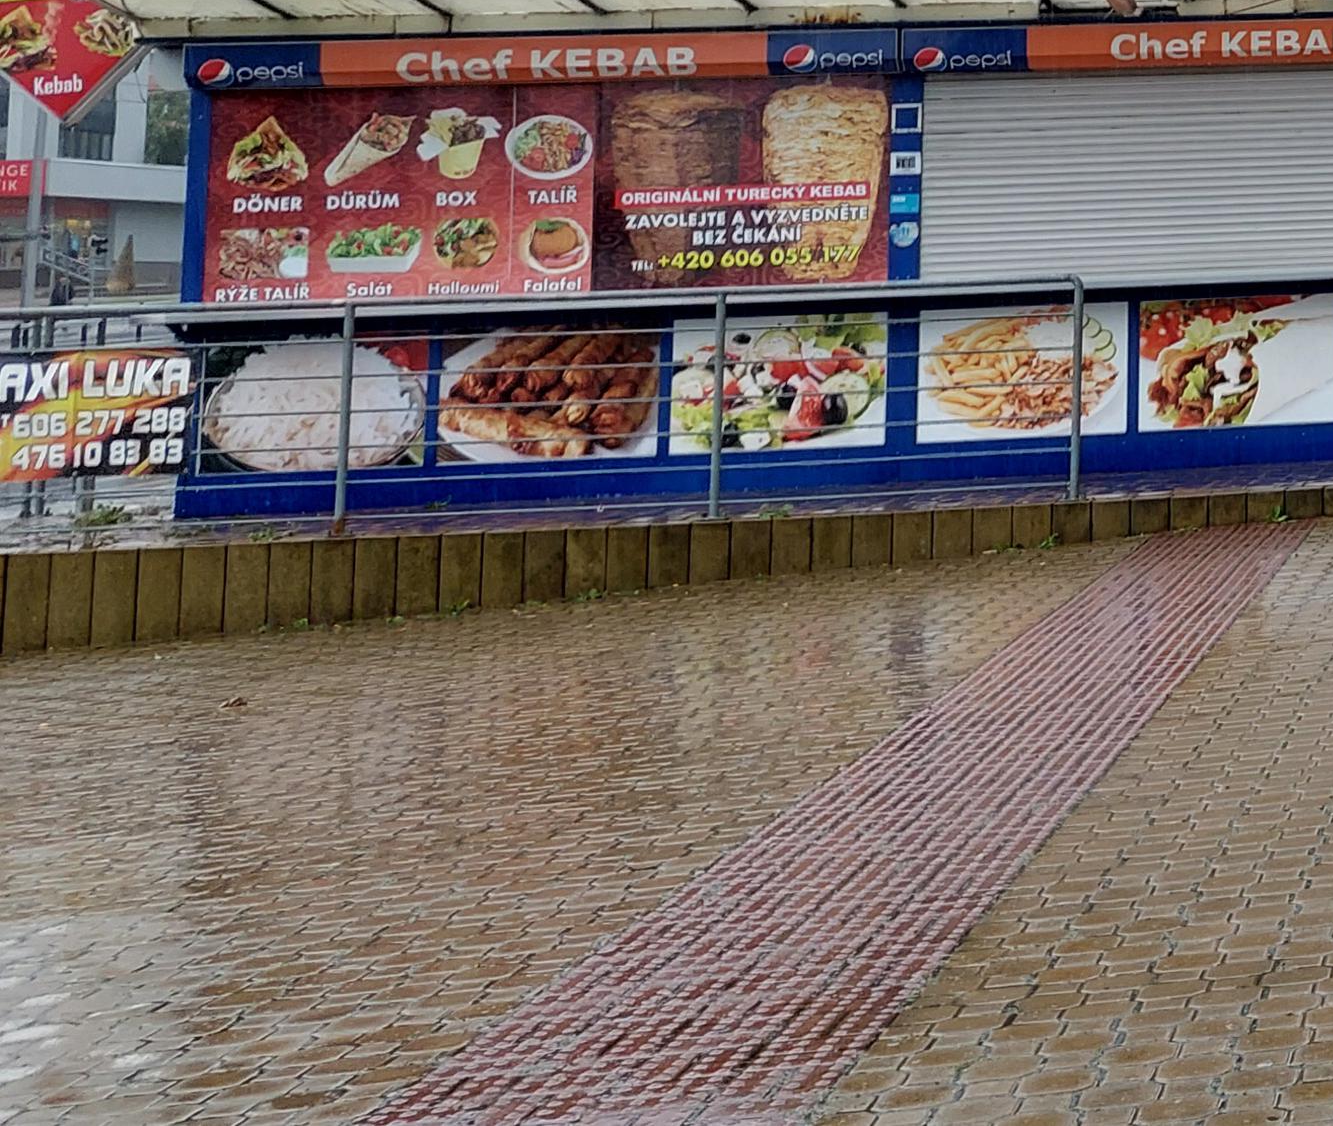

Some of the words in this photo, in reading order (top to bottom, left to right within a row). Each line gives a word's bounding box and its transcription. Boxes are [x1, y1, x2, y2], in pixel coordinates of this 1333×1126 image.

[1110, 31, 1206, 61] Chef
[396, 50, 512, 82] Chef
[531, 47, 698, 78] KEBAB
[820, 49, 883, 71] pepsi
[950, 51, 1011, 70] pepsi
[237, 62, 304, 82] pepsi
[34, 74, 82, 96] Kebab
[233, 194, 302, 213] DÖNER
[326, 191, 399, 209] DÜRÜM
[436, 191, 476, 206] BOX
[528, 188, 577, 205] TALÍŘ
[621, 187, 720, 205] ORIGINÁLNÍ
[725, 184, 806, 202] TURECKÝ
[810, 184, 867, 198] KEBAB
[625, 210, 726, 230] ZAVOLEJTE
[732, 210, 746, 225] A
[751, 204, 868, 224] VYZVEDNĚTE
[692, 229, 726, 246] BEZ
[732, 224, 801, 245] ČEKÁNÍ
[657, 250, 715, 269] +420
[720, 249, 764, 267] 606
[769, 246, 812, 264] 055
[821, 245, 863, 263] 177
[216, 285, 258, 302] RÝŽE
[263, 282, 310, 300] TALÍŘ
[347, 283, 392, 297] Salát
[428, 281, 499, 295] Halloumi
[524, 276, 582, 293] Falafel
[0, 360, 69, 402] AXI
[82, 357, 191, 398] LUKA
[12, 412, 68, 439] 606
[75, 409, 126, 437] 277
[132, 407, 186, 434] 288
[11, 443, 67, 471] 476
[73, 441, 103, 468] 10
[109, 439, 141, 466] 83
[150, 438, 184, 464] 83
